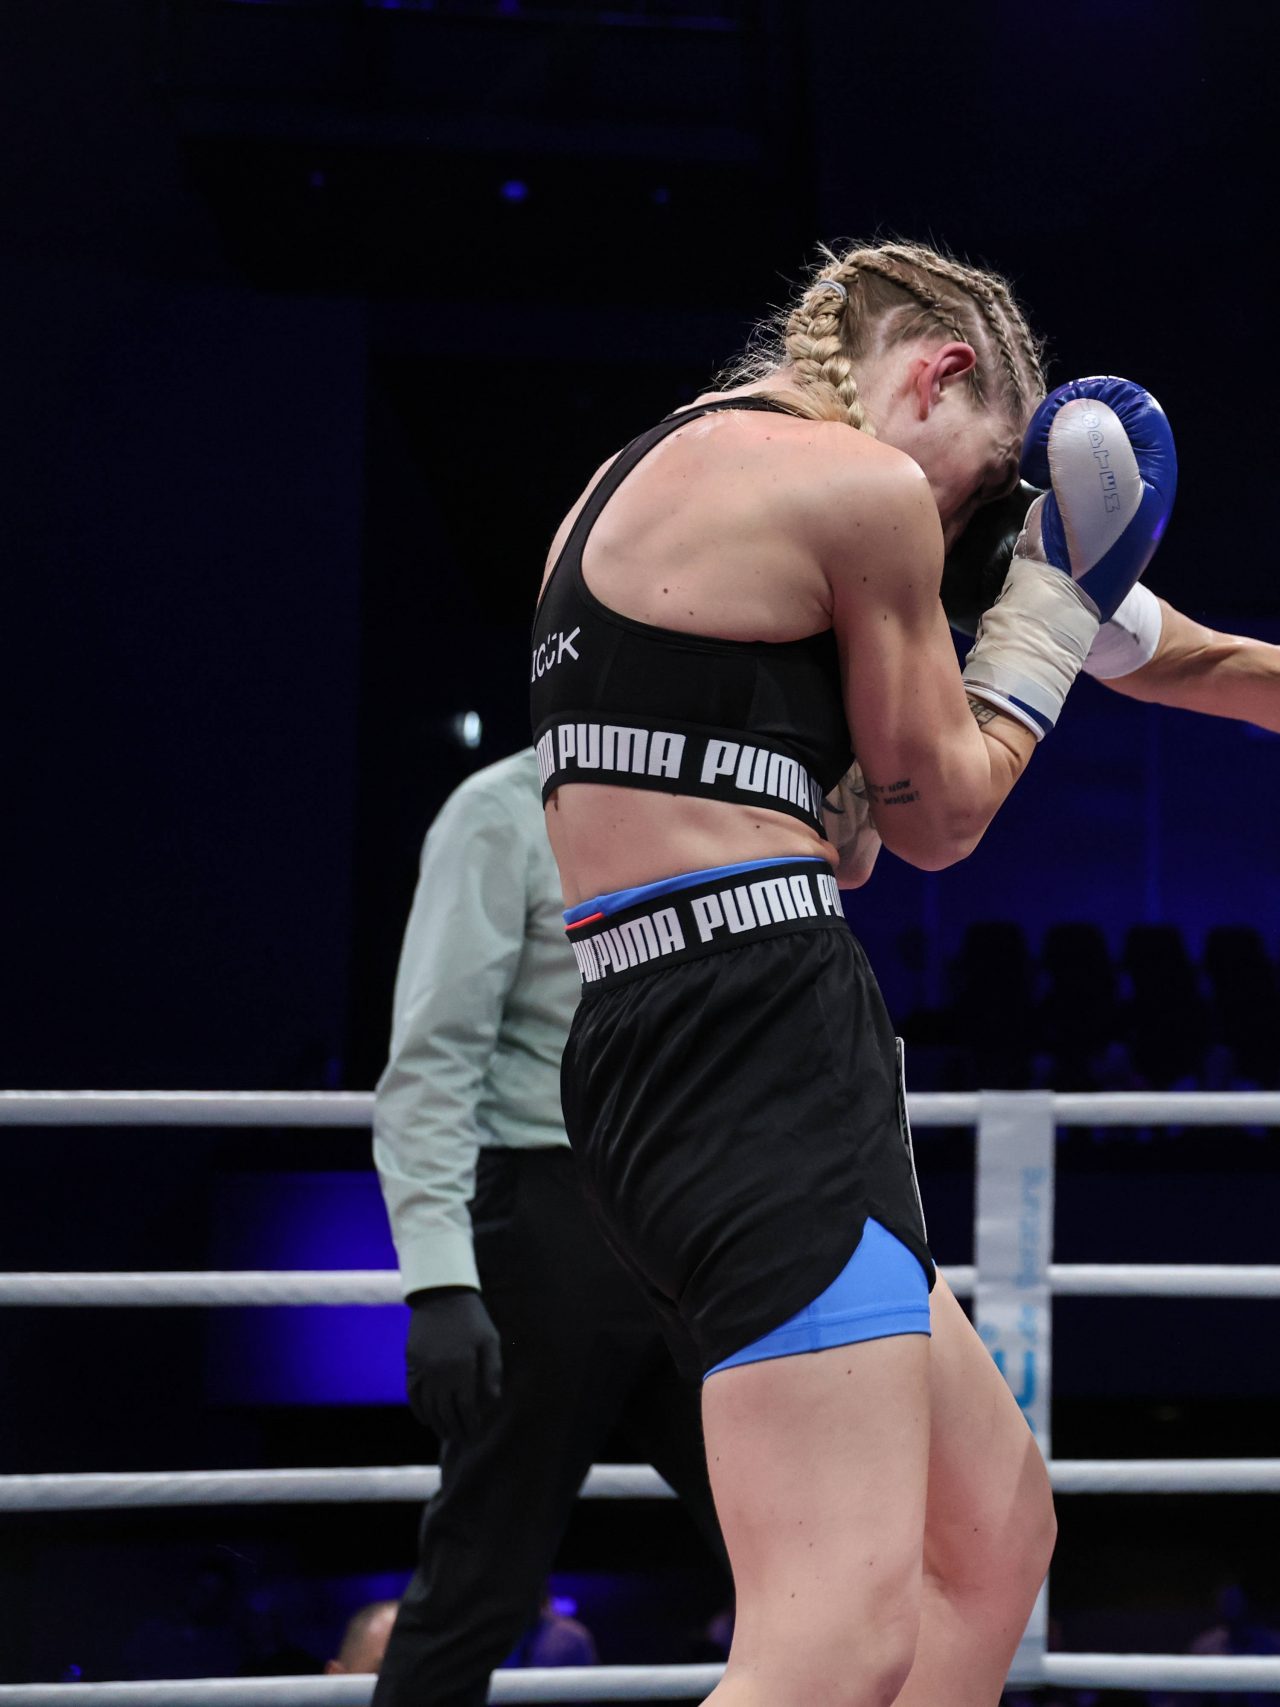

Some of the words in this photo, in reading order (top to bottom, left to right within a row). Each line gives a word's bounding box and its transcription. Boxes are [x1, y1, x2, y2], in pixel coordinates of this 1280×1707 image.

[558, 724, 687, 779] PUMA
[700, 739, 812, 814] PUMA
[593, 907, 686, 978] PUMA
[691, 875, 819, 943] PUMA
